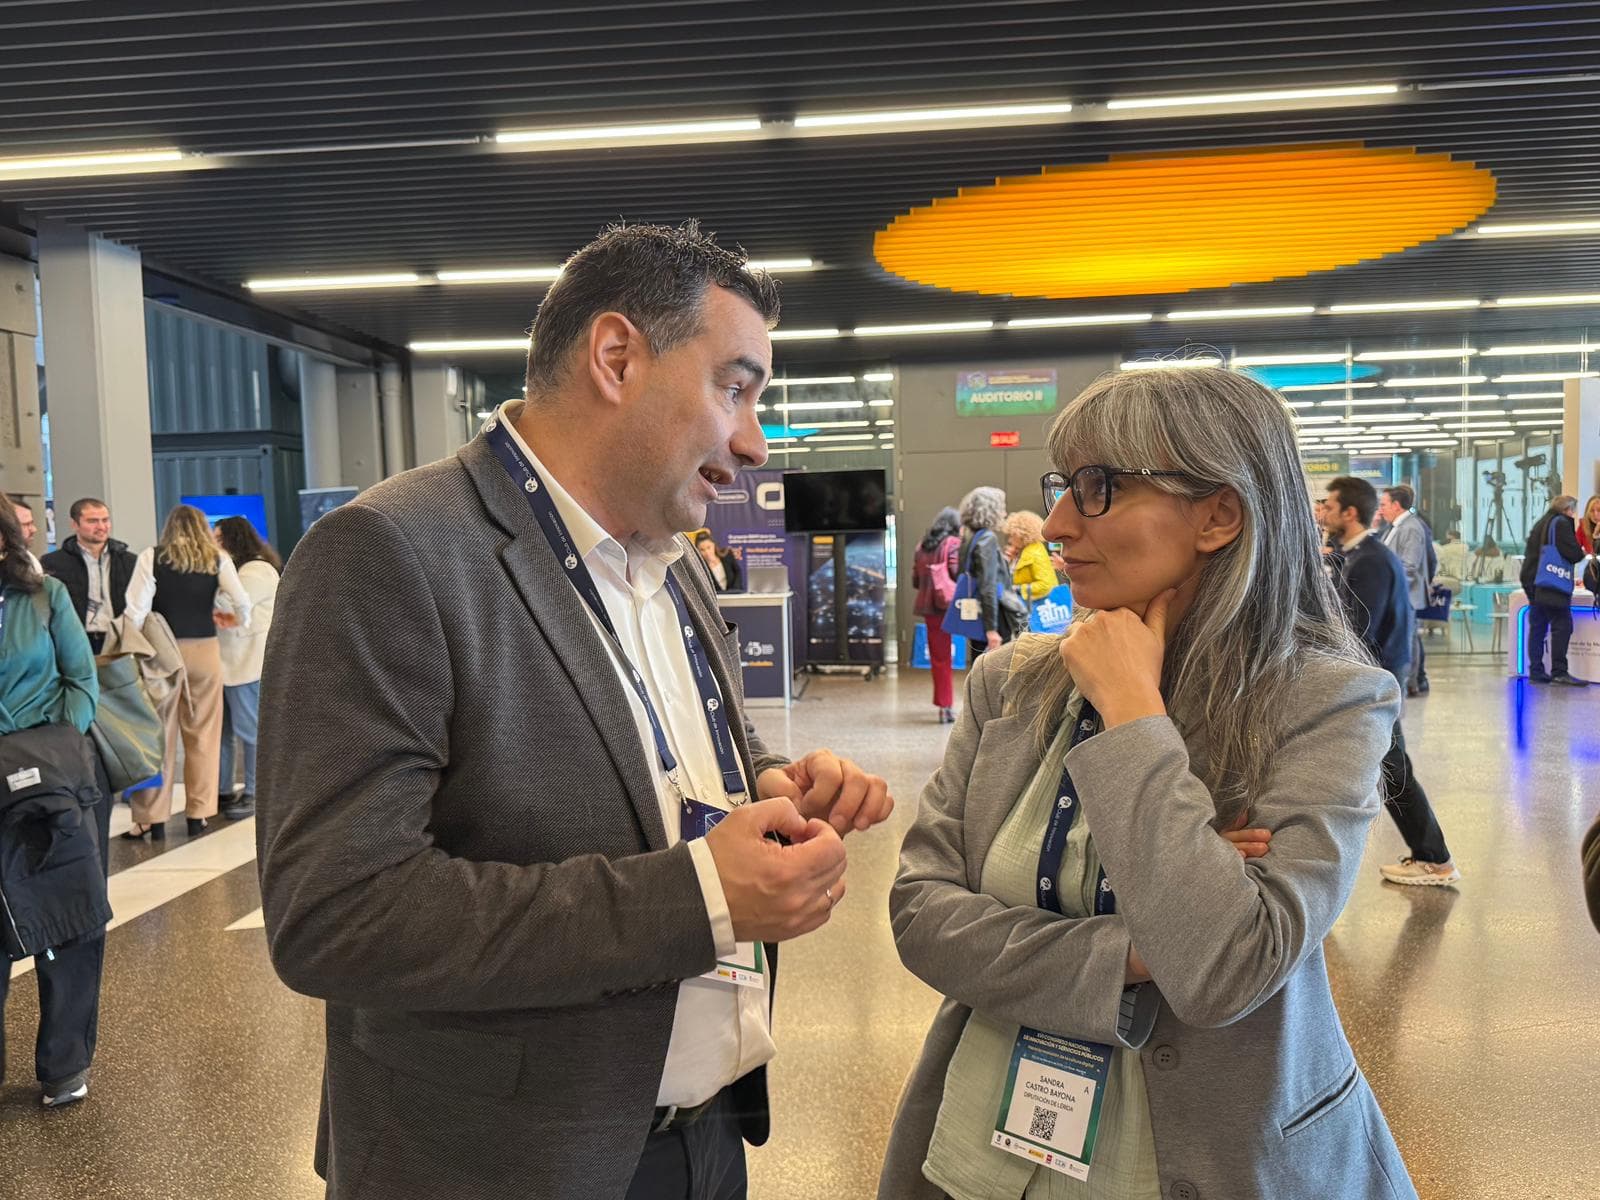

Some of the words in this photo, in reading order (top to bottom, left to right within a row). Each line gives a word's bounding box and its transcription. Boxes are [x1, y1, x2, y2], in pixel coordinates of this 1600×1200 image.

[970, 390, 1034, 403] AUDITORIO
[1040, 1075, 1064, 1089] SANDRA
[1025, 1081, 1049, 1094] CASTRO
[1049, 1089, 1076, 1103] BAYONA
[1084, 1086, 1090, 1095] A
